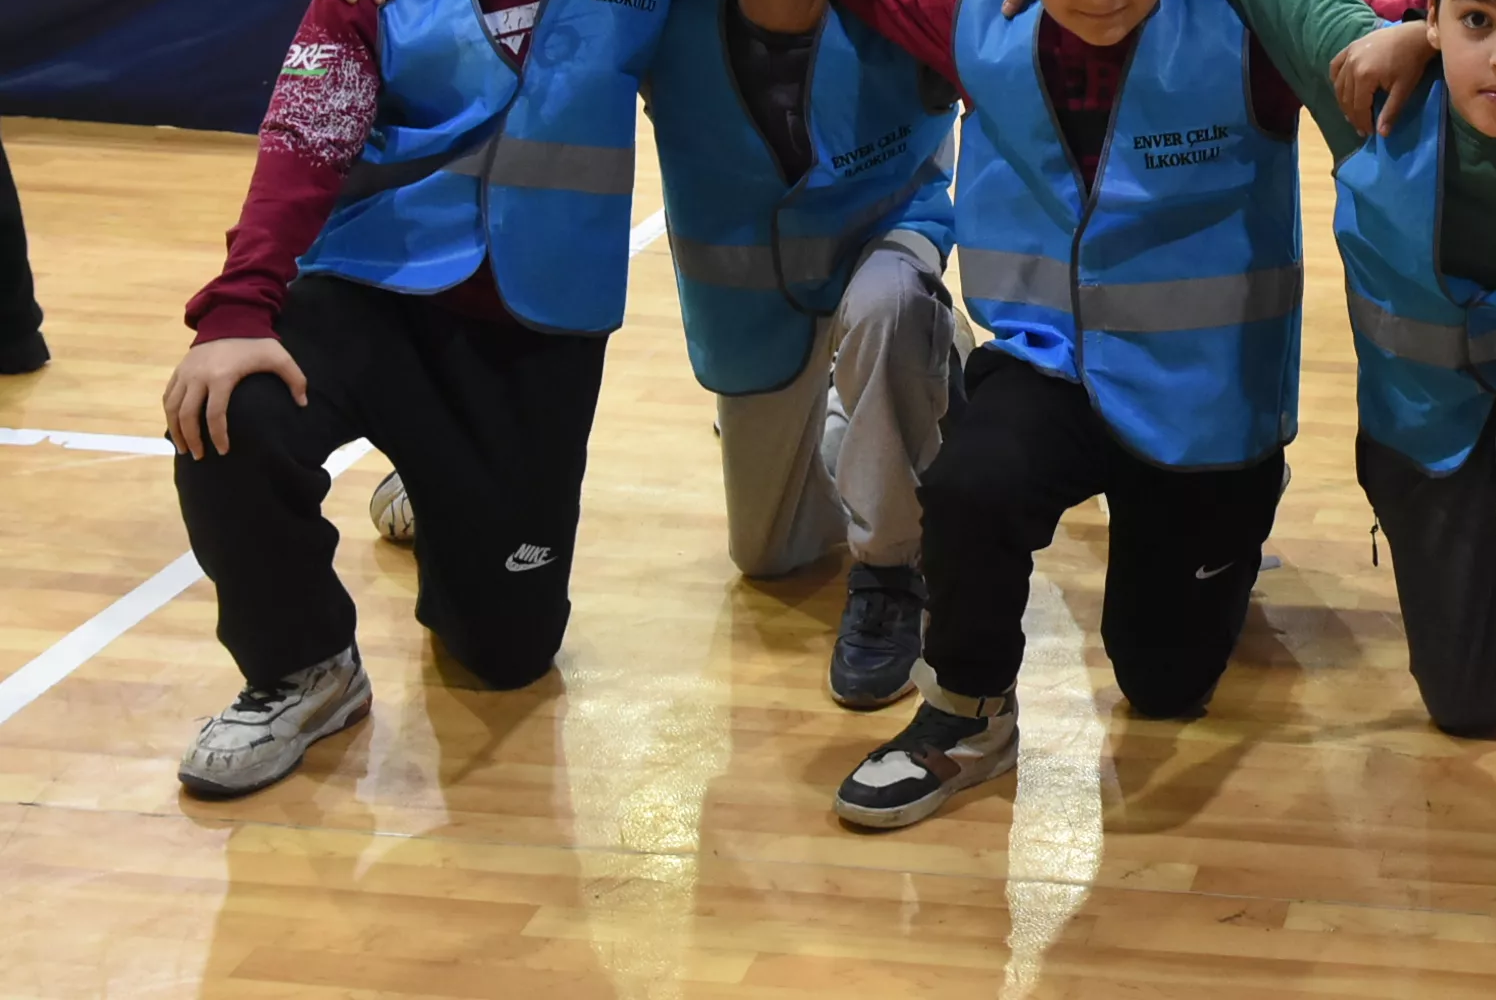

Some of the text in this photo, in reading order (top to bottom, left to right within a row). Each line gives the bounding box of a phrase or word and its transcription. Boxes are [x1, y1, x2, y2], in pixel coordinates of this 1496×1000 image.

[1134, 125, 1229, 150] ENVER ÇELİK
[832, 143, 875, 169] ENVER
[1145, 146, 1220, 169] İLKOKULU
[514, 543, 551, 563] NIKE
